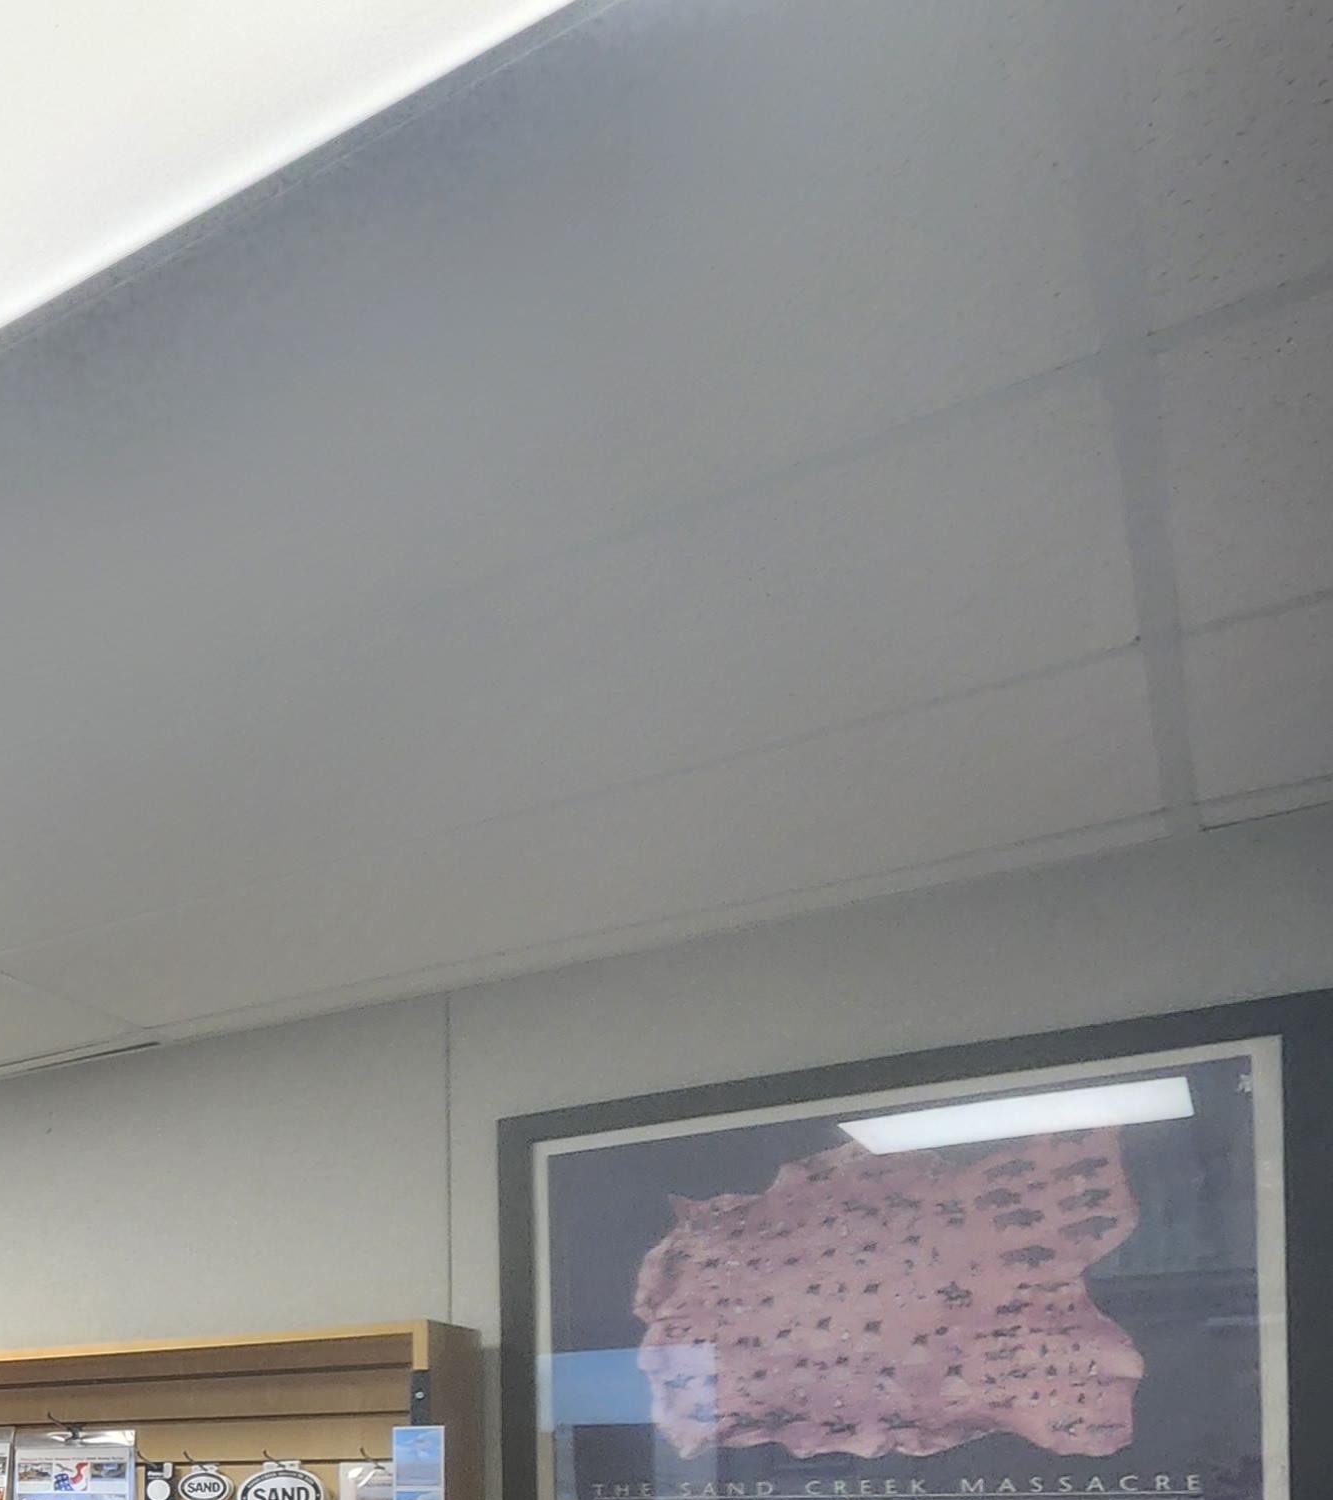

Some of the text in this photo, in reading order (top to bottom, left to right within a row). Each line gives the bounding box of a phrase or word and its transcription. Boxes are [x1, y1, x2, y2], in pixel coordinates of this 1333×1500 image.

[187, 1482, 221, 1493] SAND
[592, 1474, 1202, 1497] THE SAND CREEK MASSACRE
